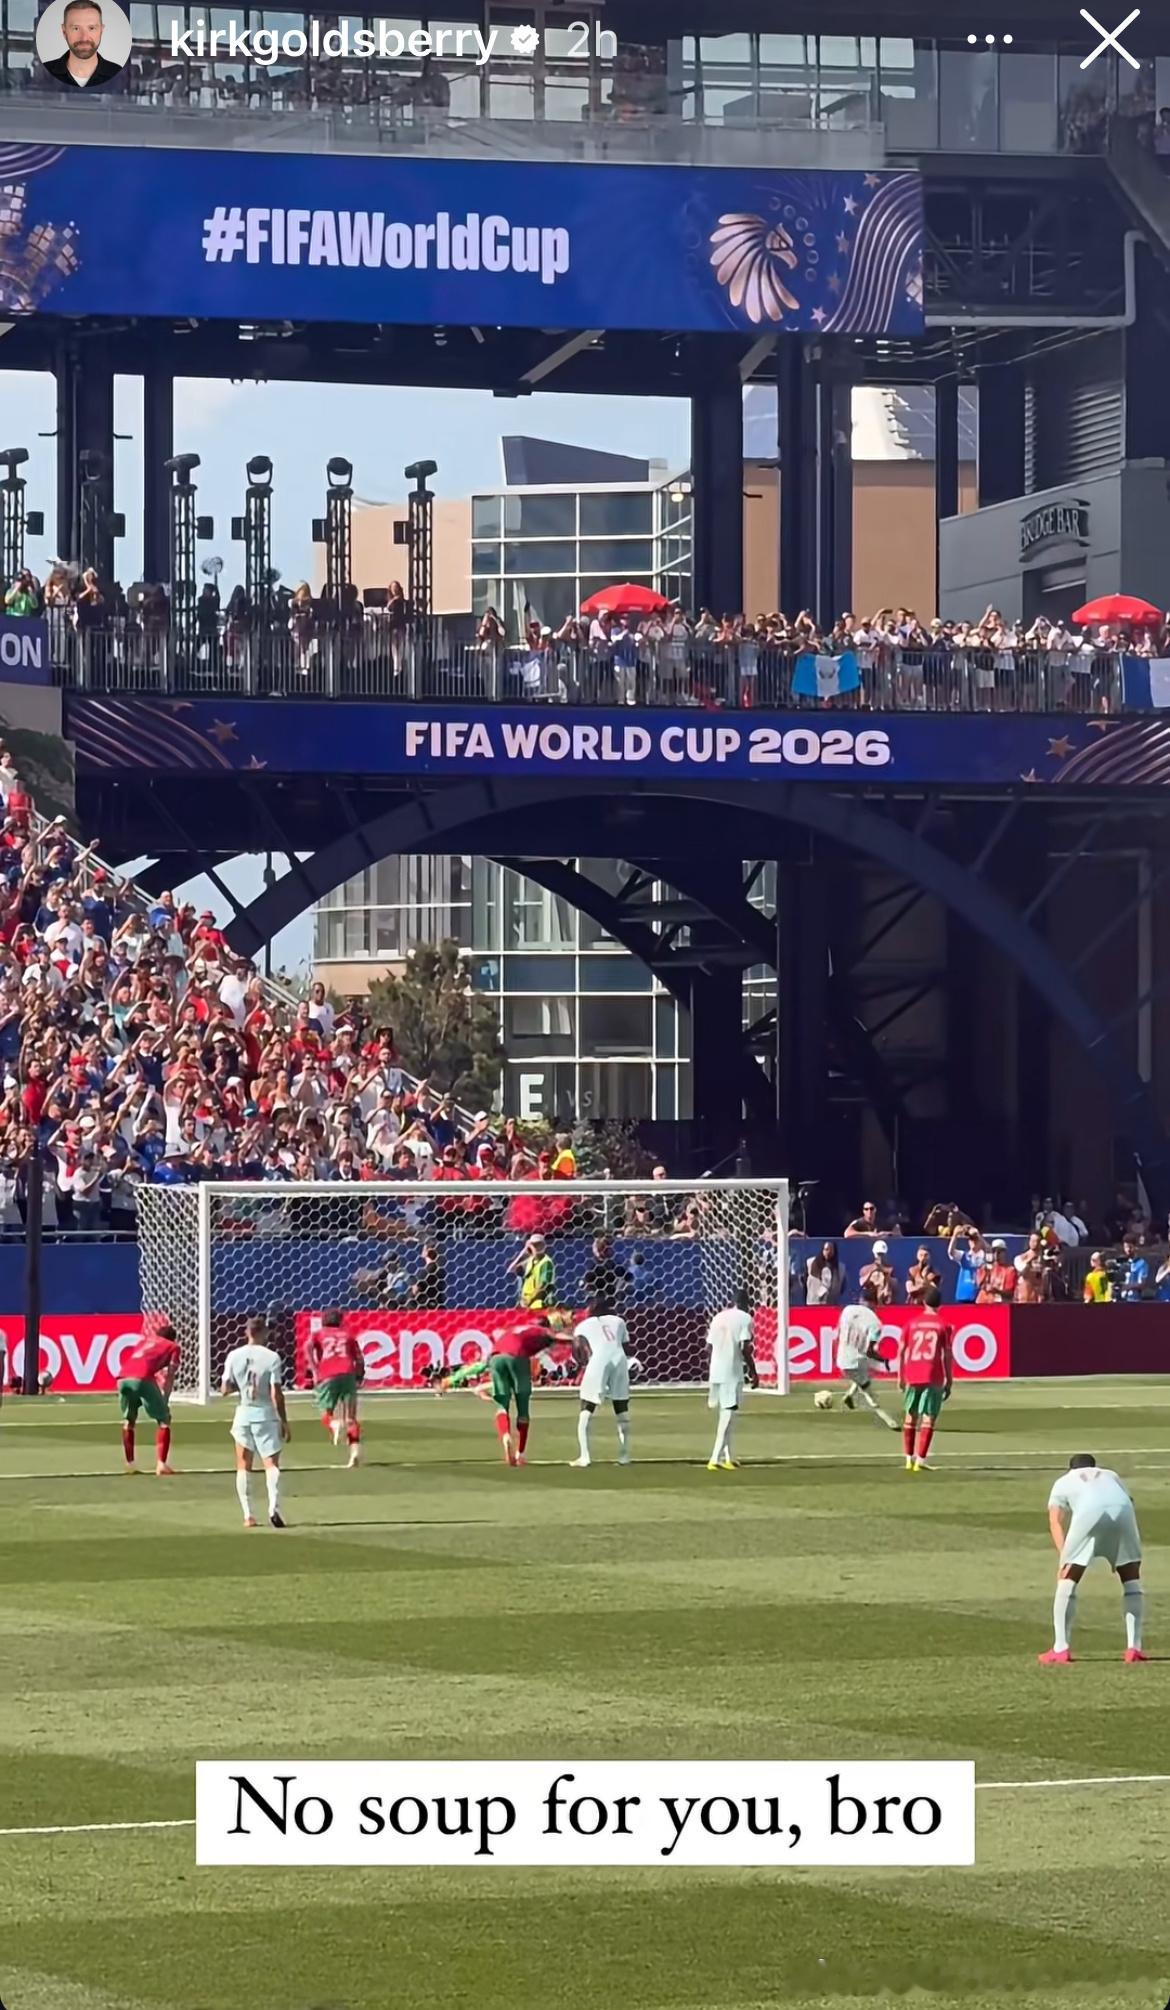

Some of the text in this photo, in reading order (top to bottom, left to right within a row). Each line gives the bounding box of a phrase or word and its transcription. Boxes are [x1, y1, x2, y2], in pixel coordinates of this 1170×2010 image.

[202, 206, 570, 285] #FIFAWorldCup
[1057, 507, 1081, 537] BAR
[0, 633, 42, 668] ON
[405, 721, 892, 766] FIFA WORLD CUP 2026
[910, 1330, 938, 1361] 23
